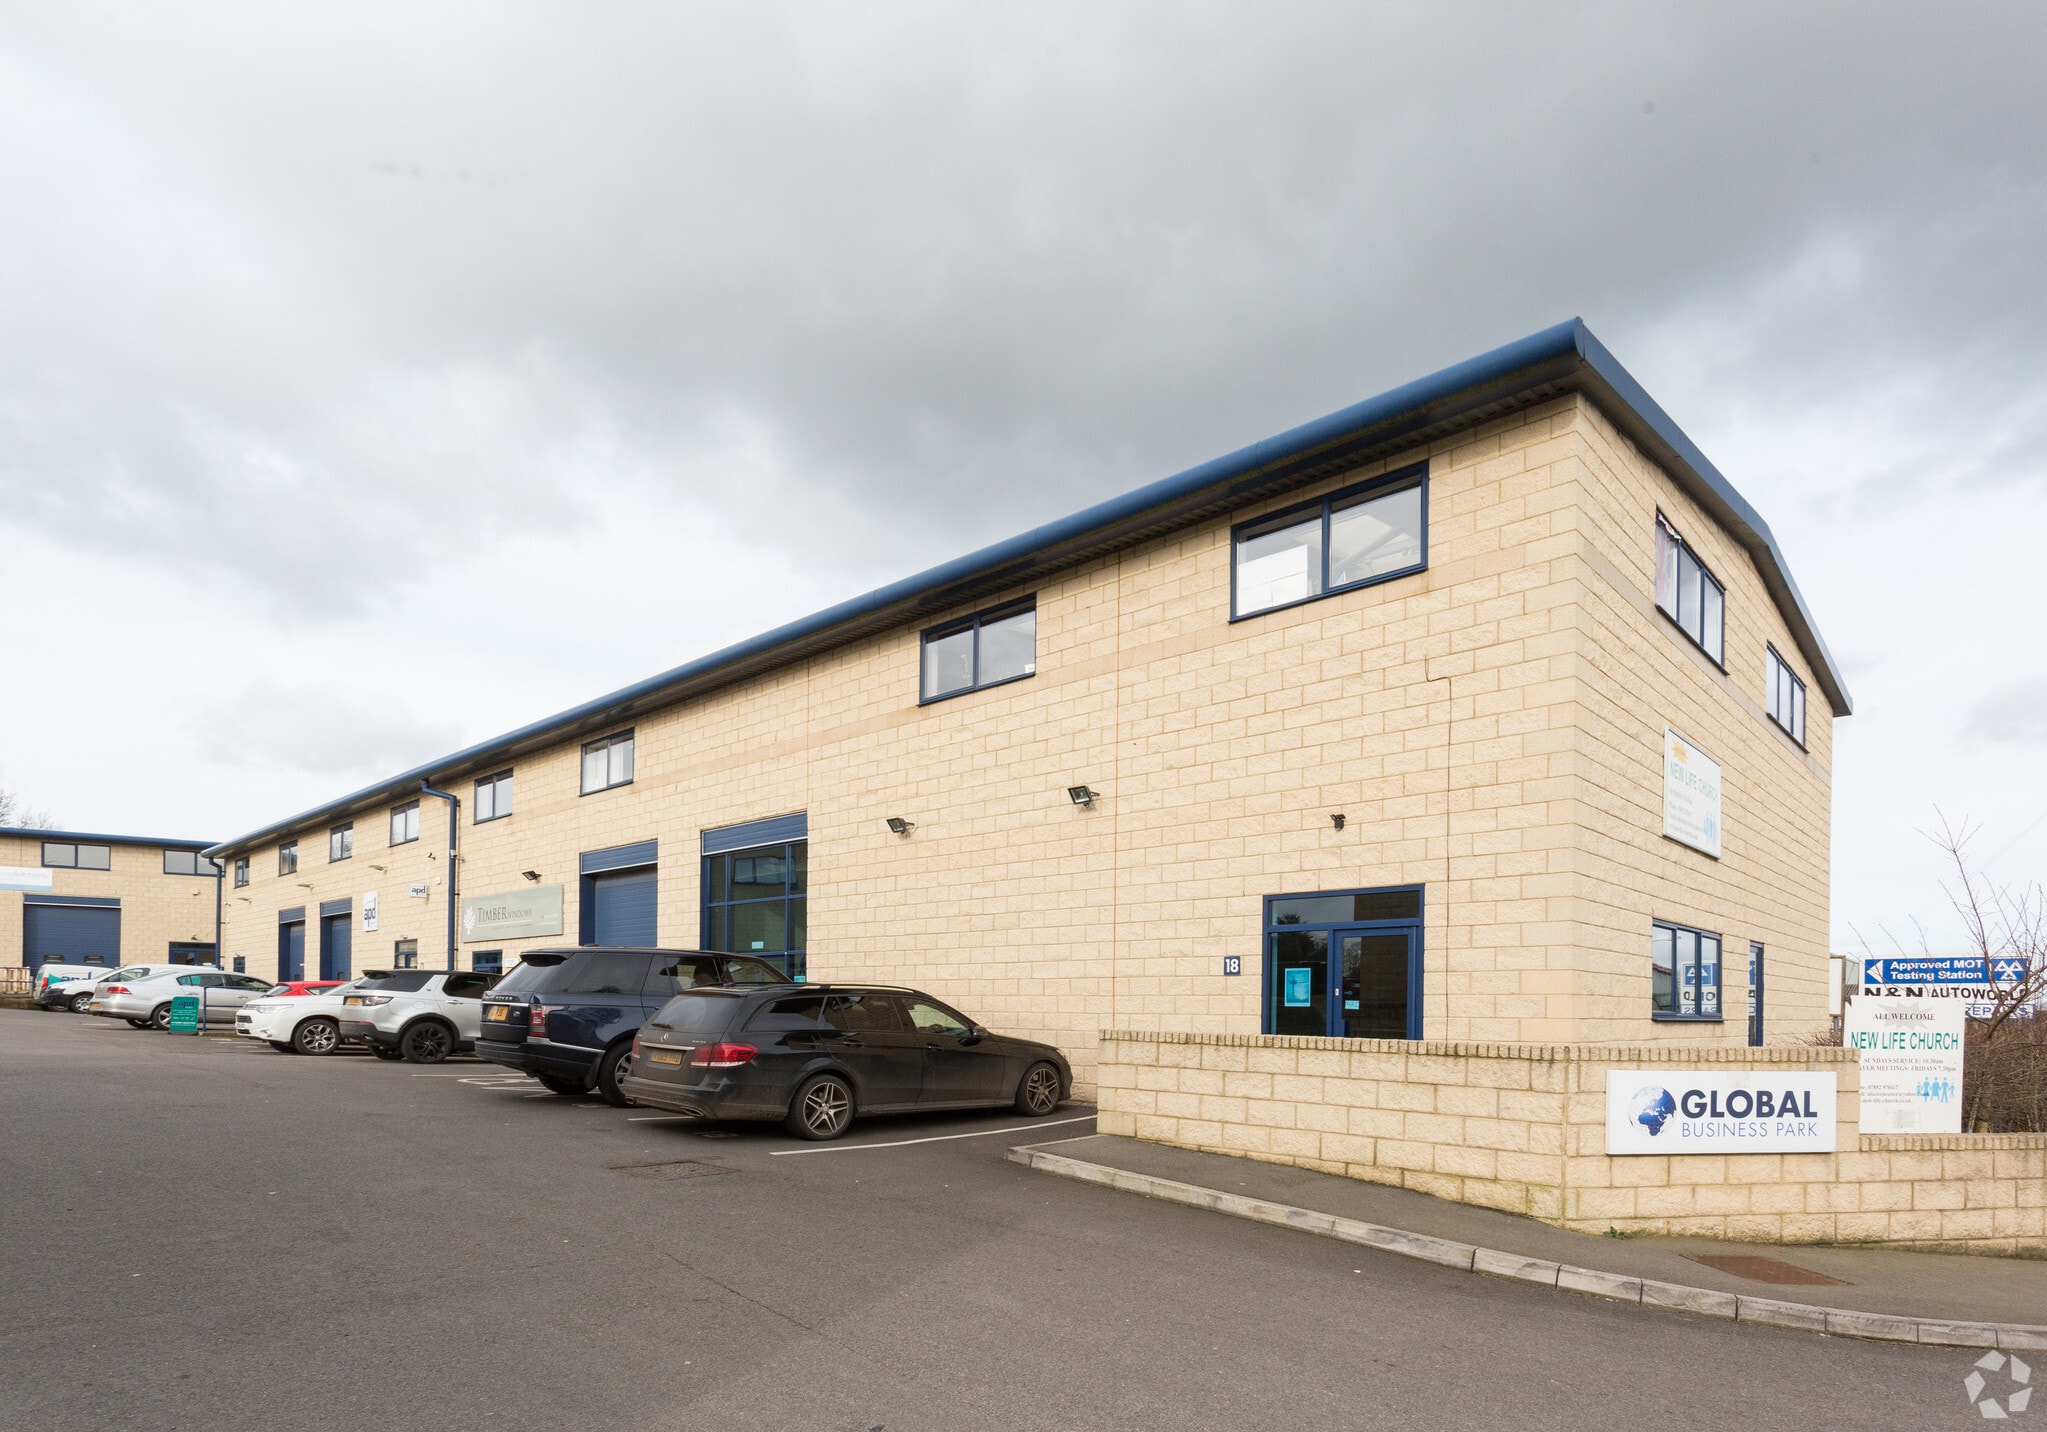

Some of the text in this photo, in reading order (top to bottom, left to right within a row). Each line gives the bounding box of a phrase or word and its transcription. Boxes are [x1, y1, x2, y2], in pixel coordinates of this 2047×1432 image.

[411, 885, 426, 896] apd
[363, 896, 376, 928] apd
[478, 906, 508, 922] TIMBER
[1225, 958, 1240, 973] 18
[1890, 959, 1984, 971] Approved MOT
[1890, 971, 1983, 981] Testing Station
[1873, 1012, 1936, 1022] ALL WELCOME
[1851, 1031, 1959, 1050] NEW LIFE CHURCH
[1680, 1089, 1818, 1119] GLOBAL
[1682, 1121, 1818, 1138] BUSINESS PARK
